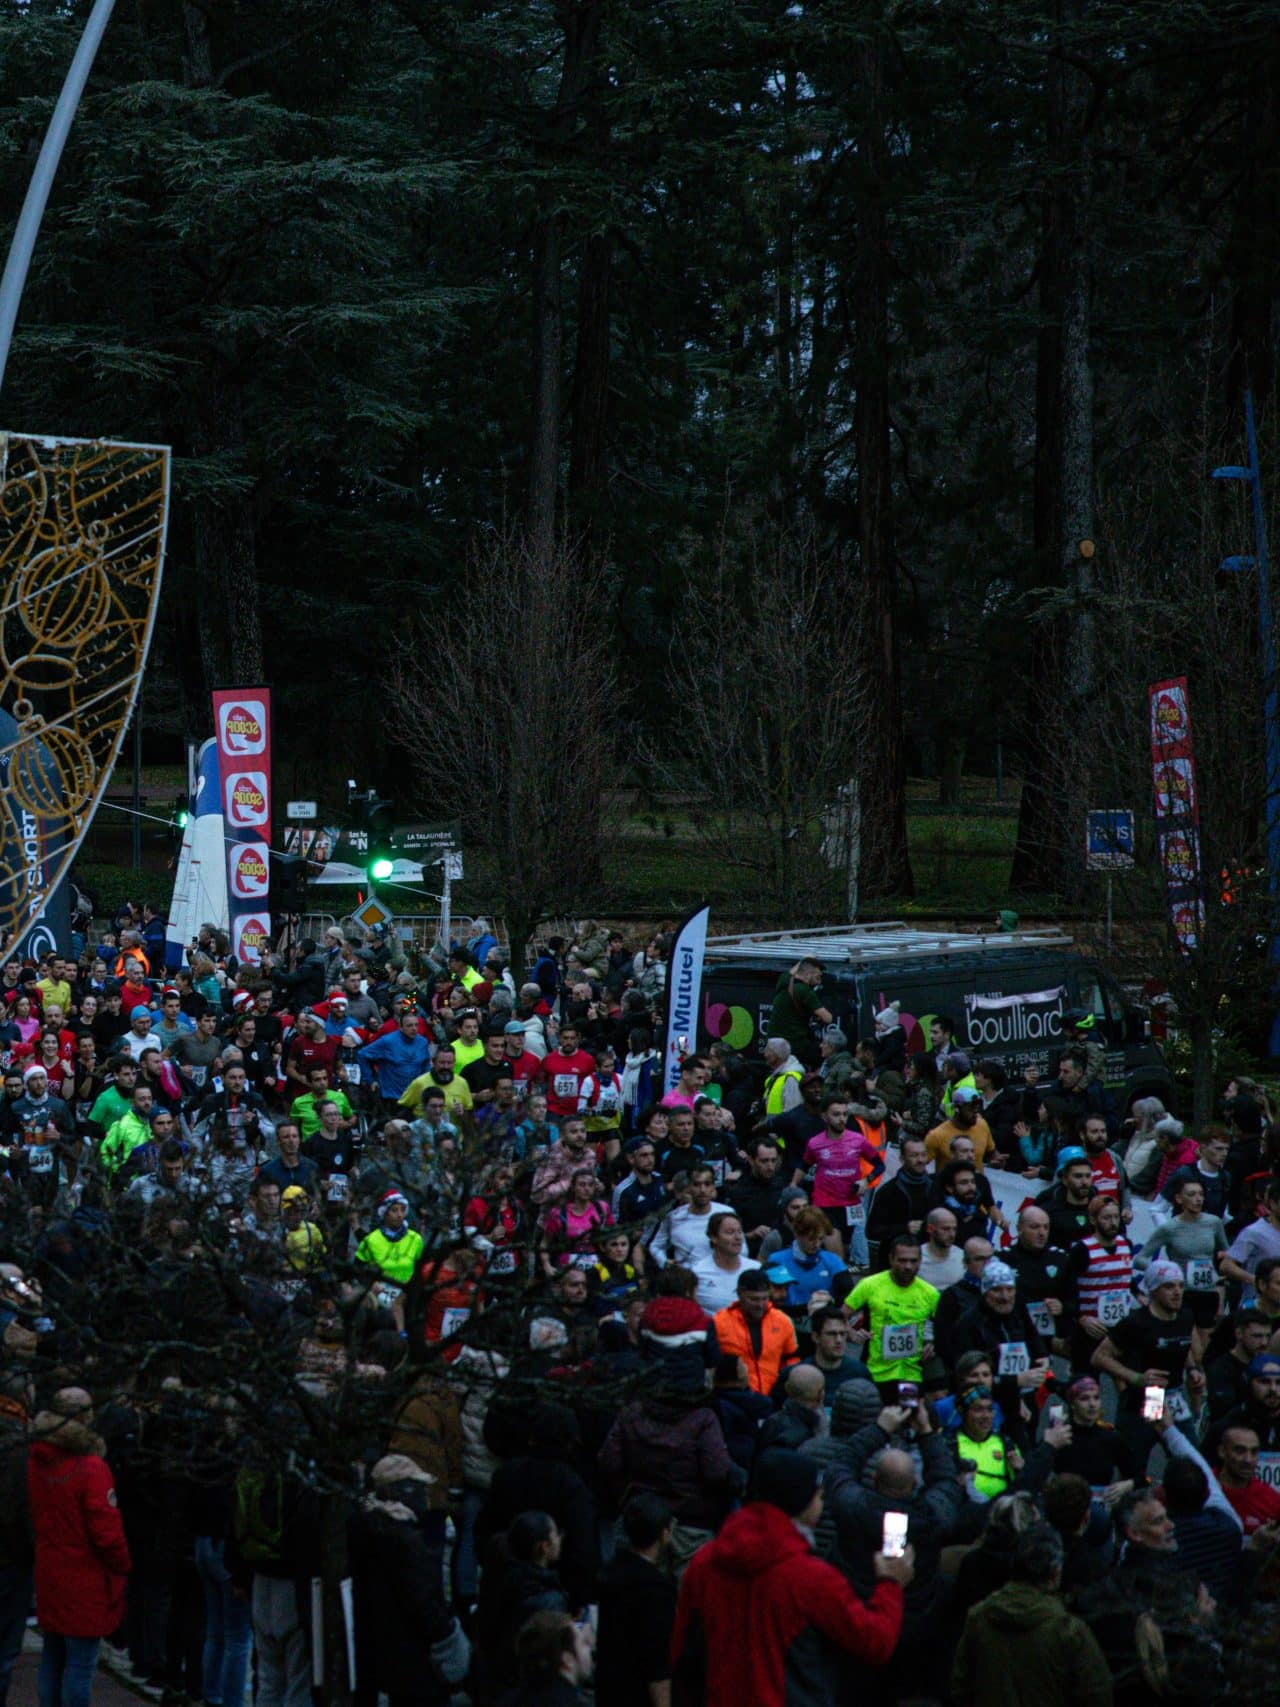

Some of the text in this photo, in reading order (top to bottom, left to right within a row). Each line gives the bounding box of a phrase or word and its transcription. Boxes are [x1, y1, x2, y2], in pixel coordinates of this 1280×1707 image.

[673, 947, 694, 1032] Mutuel
[889, 1335, 914, 1353] 636
[1004, 1355, 1026, 1372] 370
